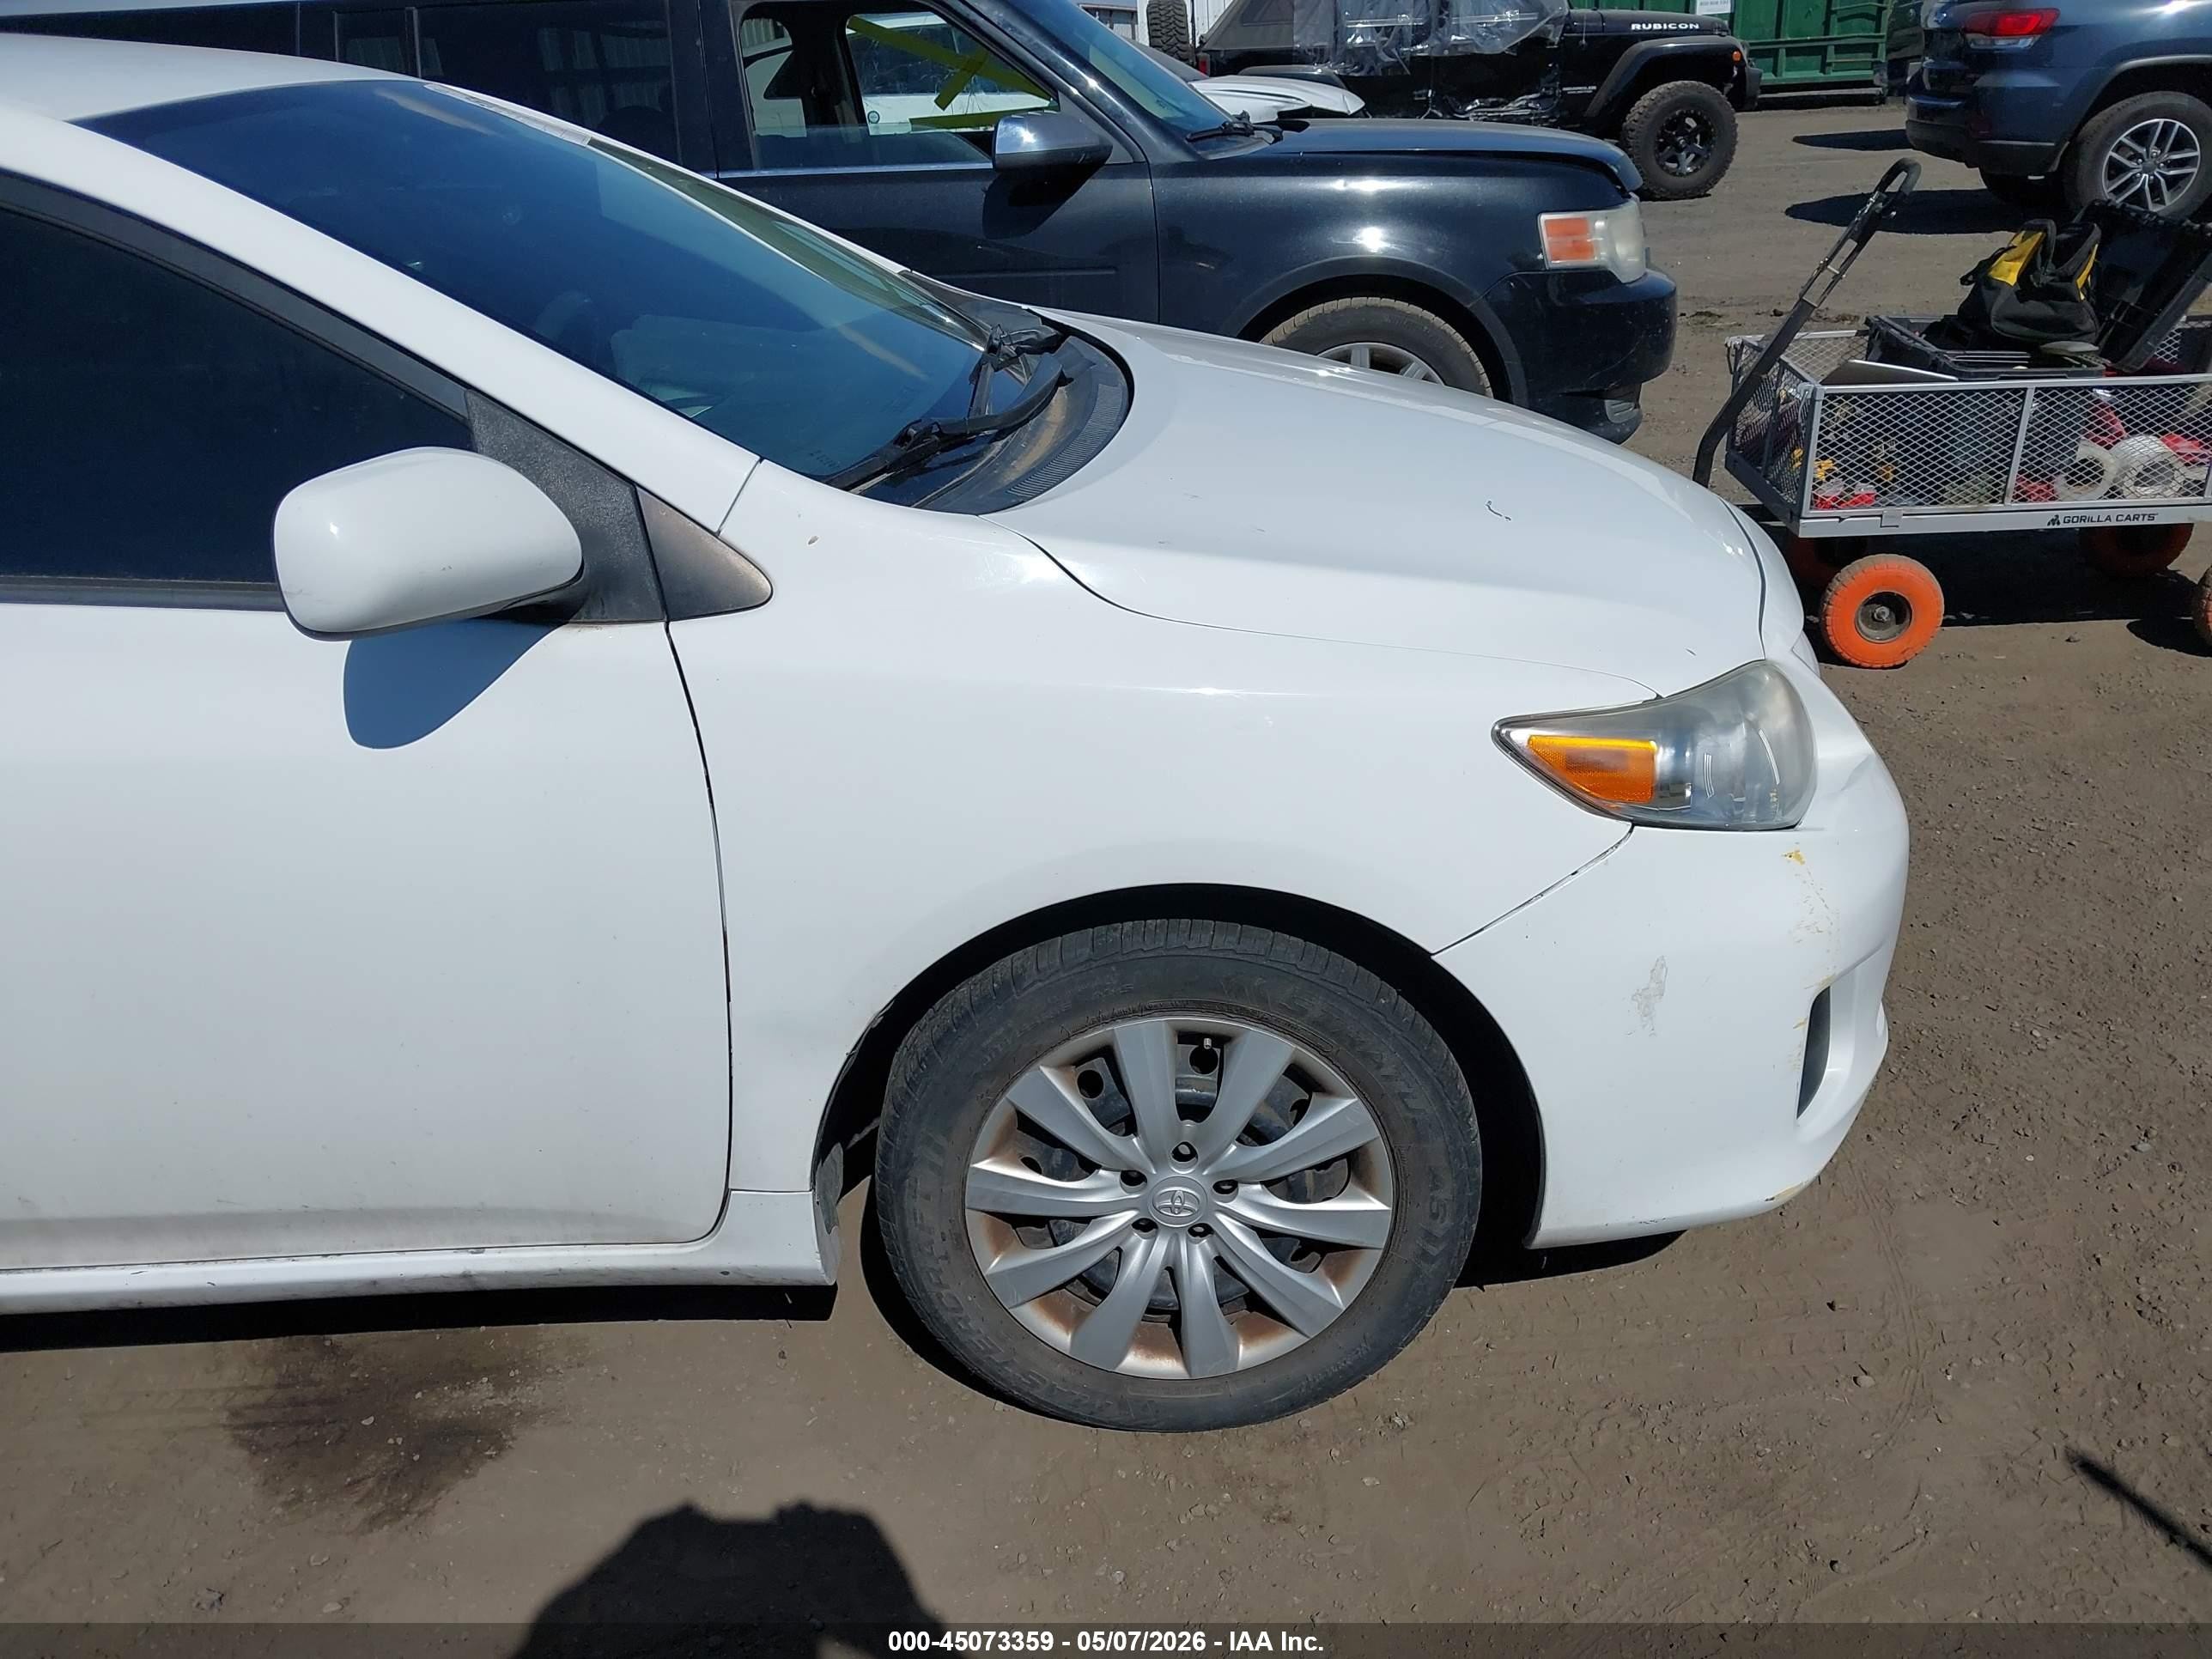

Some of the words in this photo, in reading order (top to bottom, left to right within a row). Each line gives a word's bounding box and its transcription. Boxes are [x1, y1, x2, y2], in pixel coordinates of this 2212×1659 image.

[1631, 22, 1700, 31] RUBICON
[2062, 514, 2112, 524] GORILLA
[2115, 513, 2158, 522] CARTS
